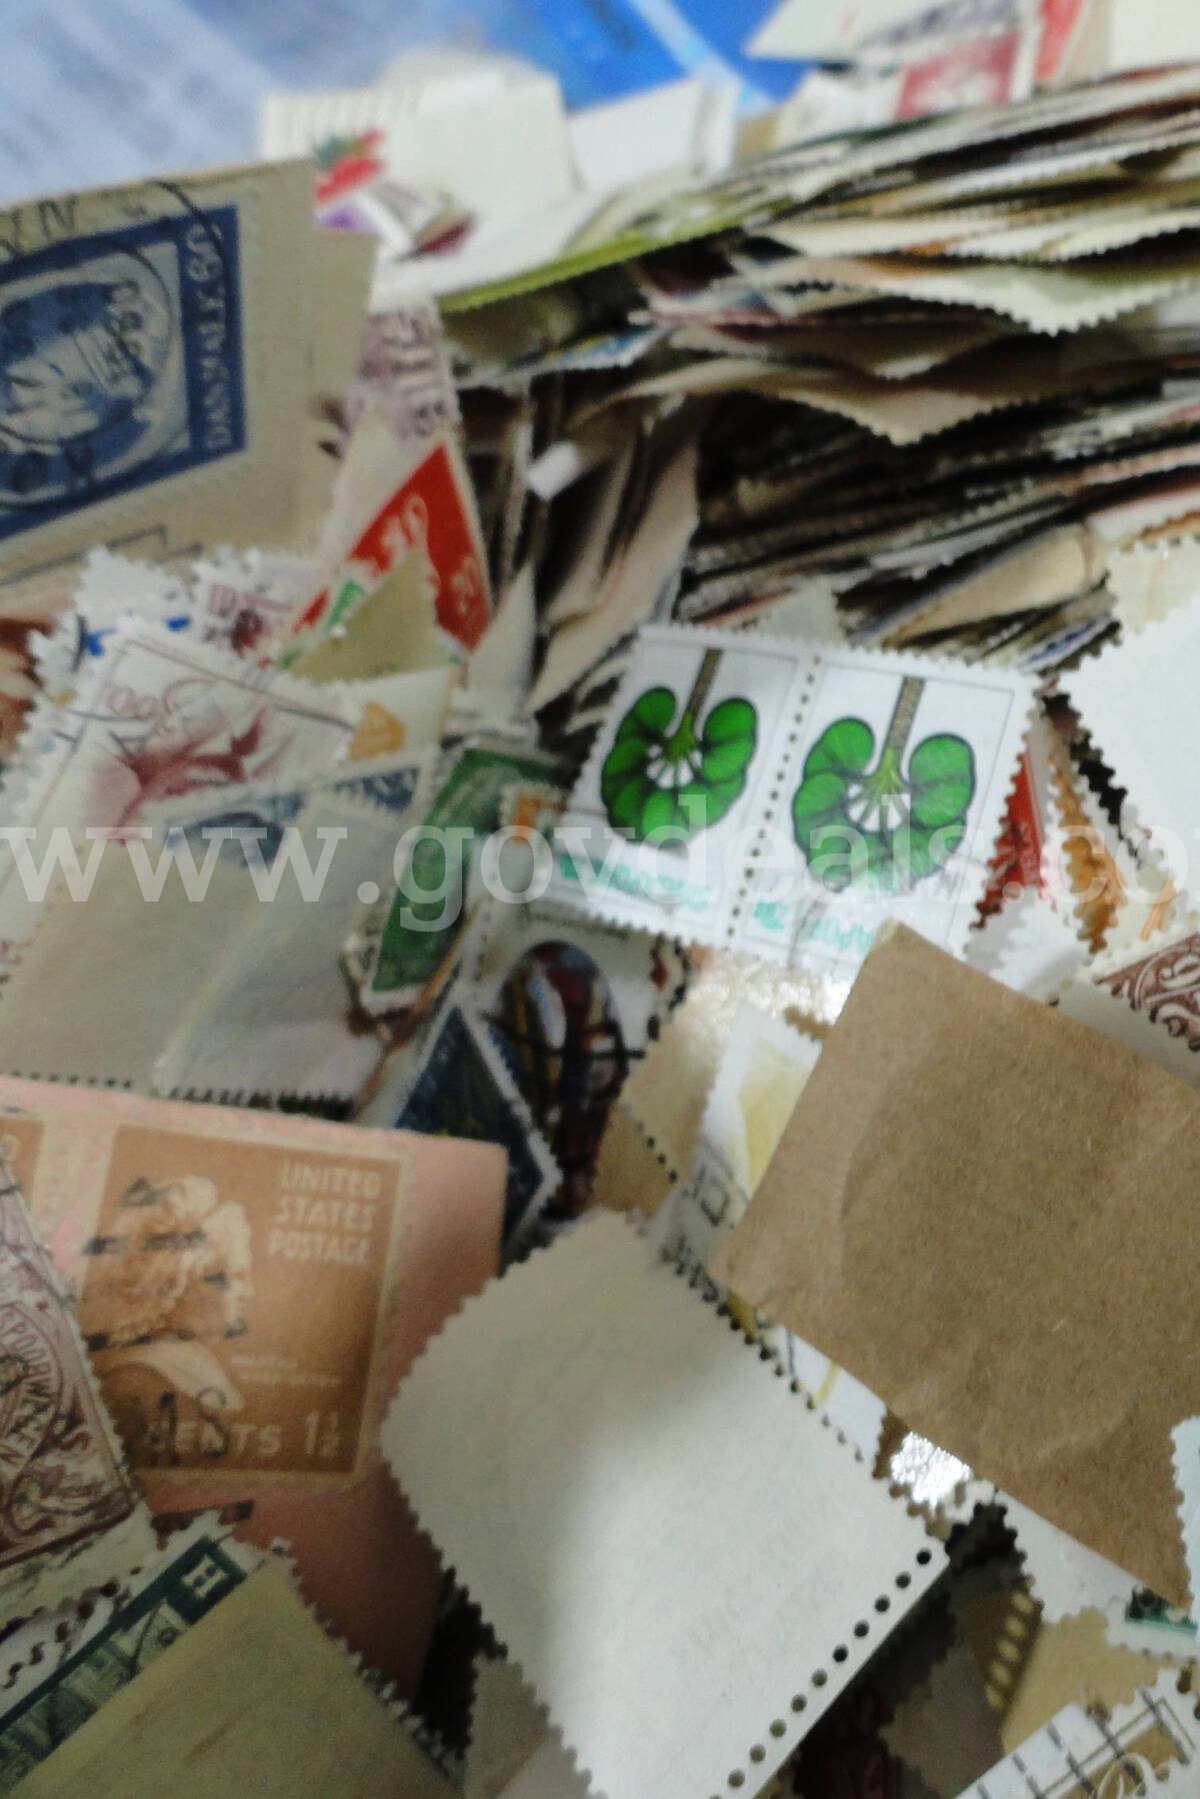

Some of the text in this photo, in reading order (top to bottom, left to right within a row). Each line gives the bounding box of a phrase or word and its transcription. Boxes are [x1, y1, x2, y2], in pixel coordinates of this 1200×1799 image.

[283, 1165, 381, 1197] UNITED
[277, 1198, 376, 1230] STATES
[268, 1231, 370, 1265] POSTAGE
